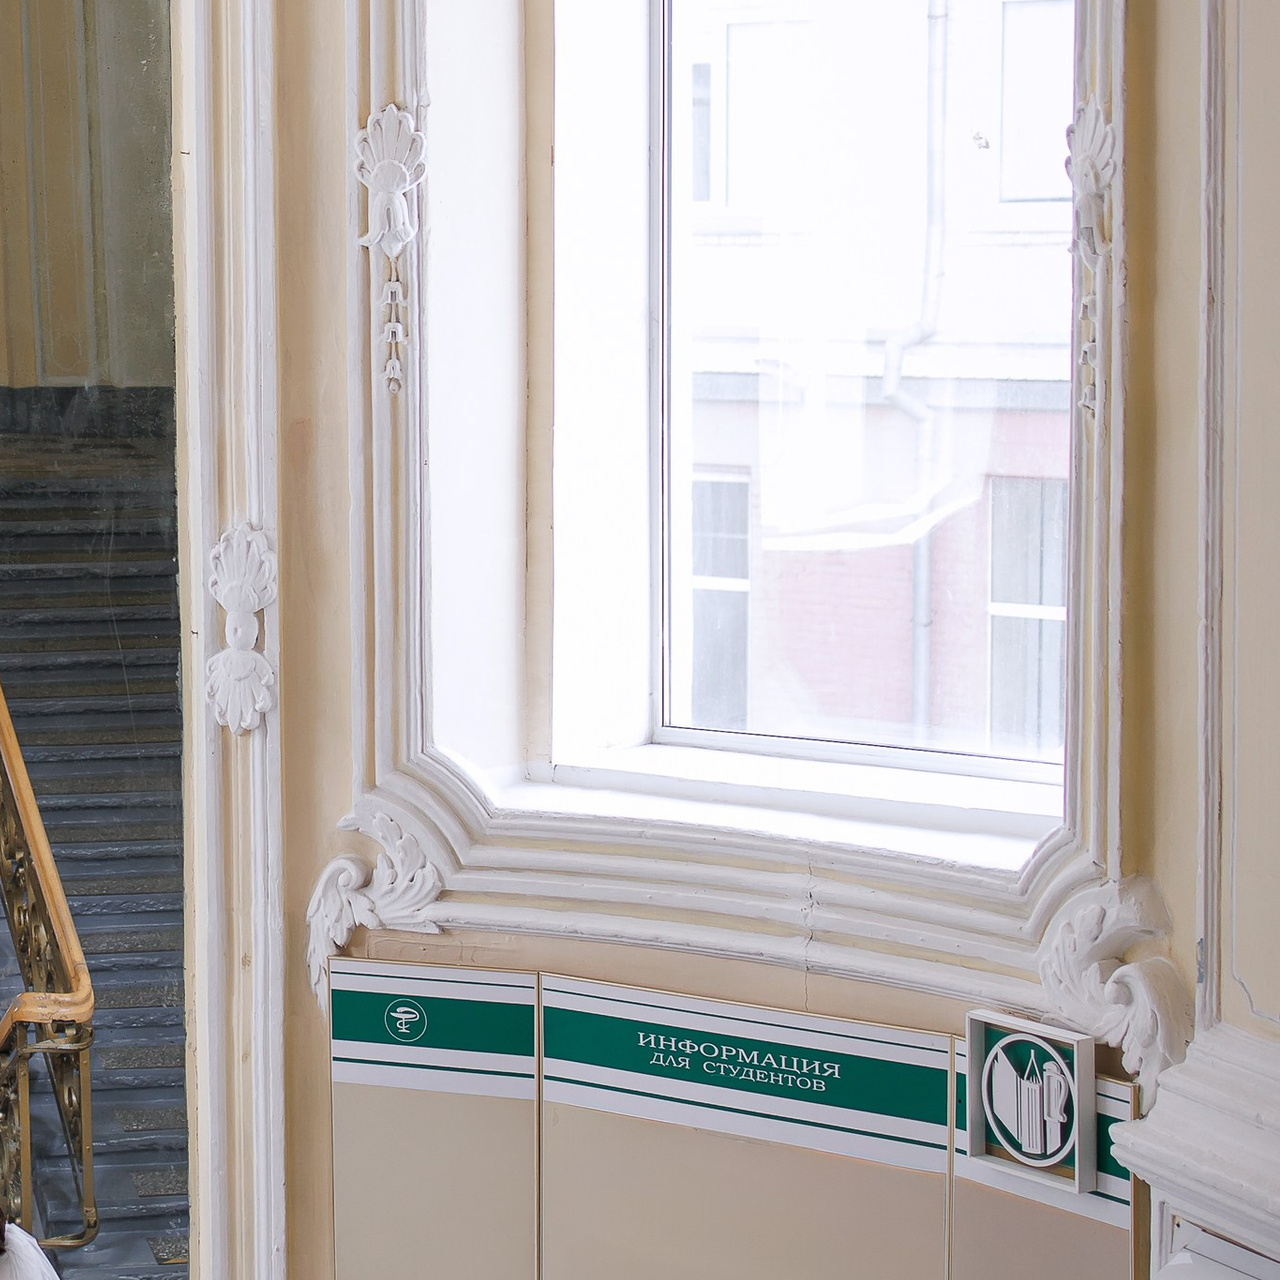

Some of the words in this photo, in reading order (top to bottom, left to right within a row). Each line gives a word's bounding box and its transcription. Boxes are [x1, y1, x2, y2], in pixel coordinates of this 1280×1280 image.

[637, 1031, 842, 1078] ИНФОРМАЦИЯ
[650, 1052, 691, 1070] ДЛЯ
[702, 1061, 827, 1092] СТУДЕНТОВ
